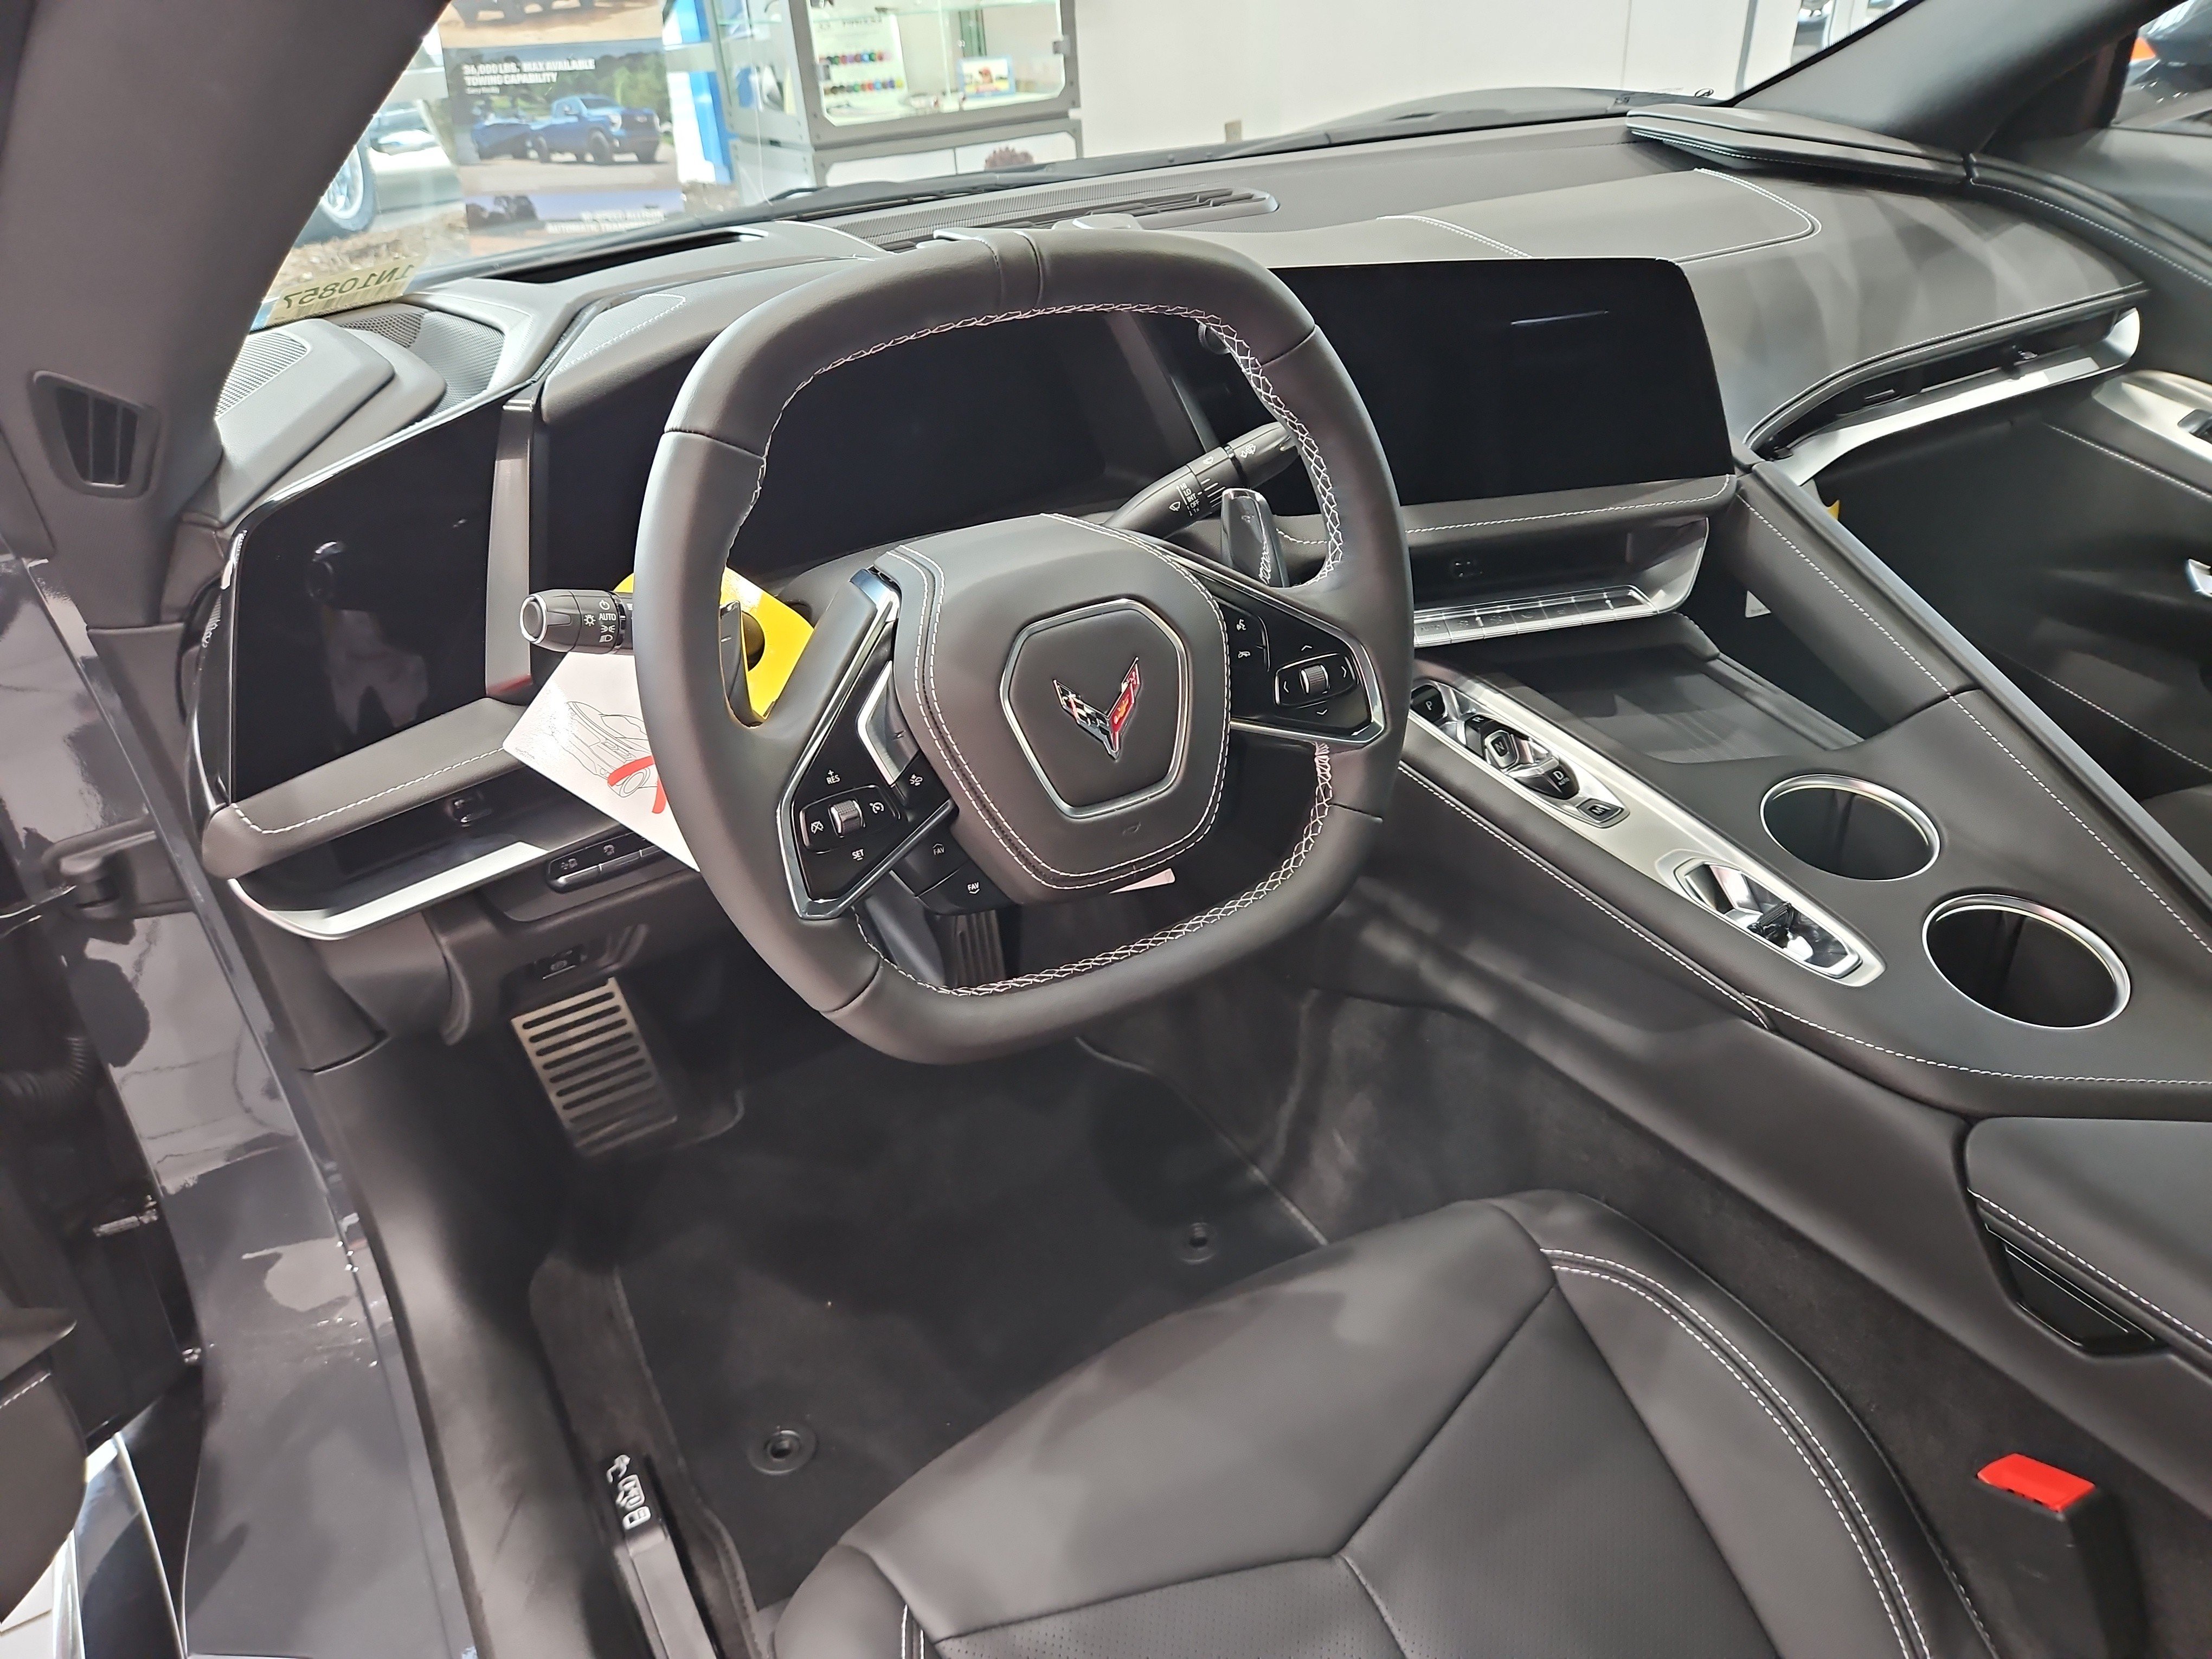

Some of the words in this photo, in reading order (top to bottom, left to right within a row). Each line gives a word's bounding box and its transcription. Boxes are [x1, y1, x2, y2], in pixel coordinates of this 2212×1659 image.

[521, 60, 545, 73] MAX
[546, 59, 596, 71] AVAILABLE
[463, 74, 503, 87] TOWING
[504, 72, 558, 85] CAPABILITY
[1186, 493, 1197, 503] INT
[1190, 498, 1200, 508] OFF
[599, 613, 617, 621] AUTO
[1425, 701, 1432, 711] P
[1494, 741, 1505, 752] N
[826, 774, 840, 785] RES
[1552, 770, 1564, 780] D
[852, 848, 864, 860] SET
[933, 847, 944, 856] FAV
[967, 882, 979, 891] FAV
